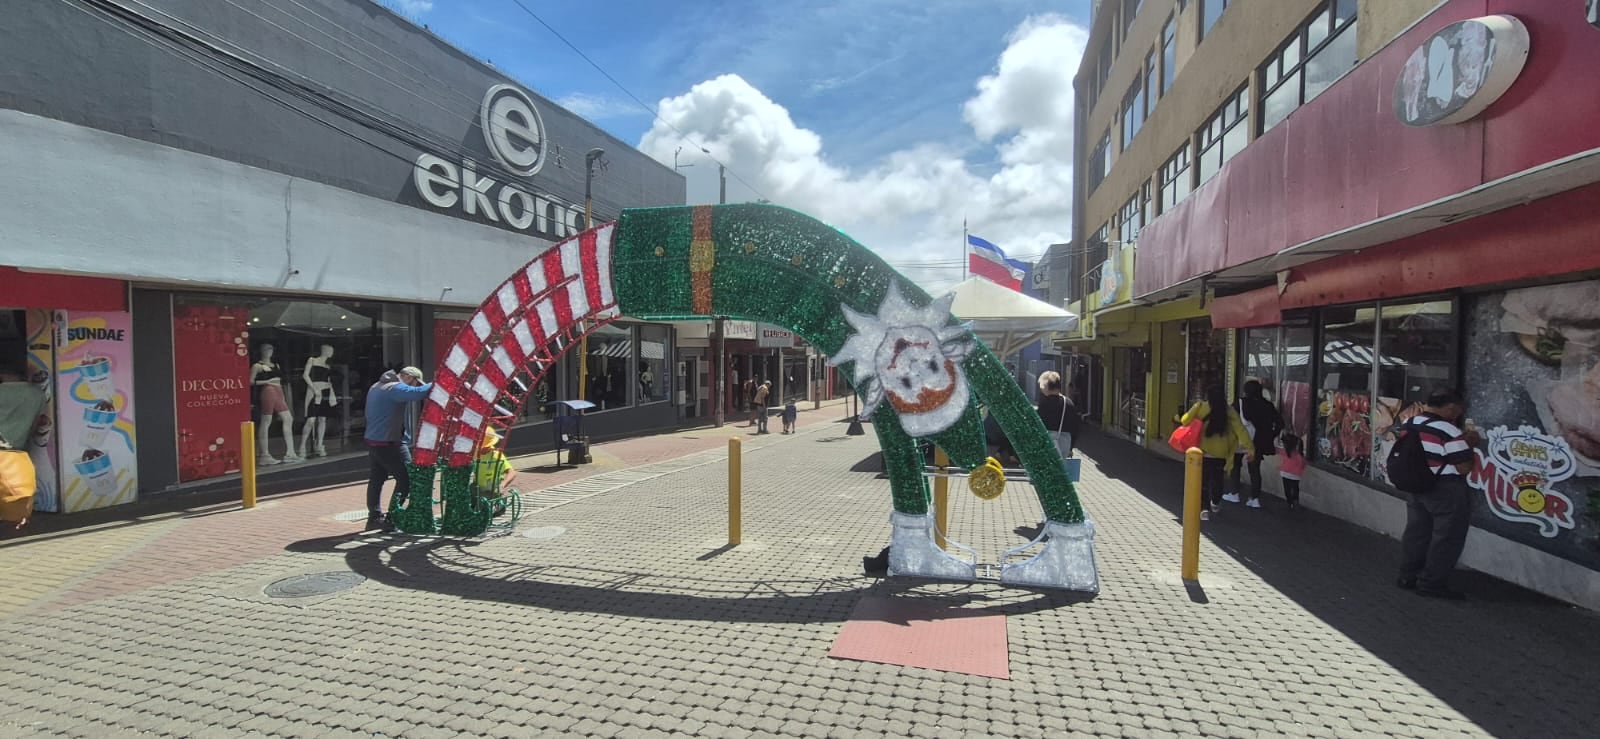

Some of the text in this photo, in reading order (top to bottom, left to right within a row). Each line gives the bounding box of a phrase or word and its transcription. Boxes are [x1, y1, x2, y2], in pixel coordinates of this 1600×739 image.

[489, 96, 541, 167] e
[67, 327, 125, 342] SUNDAE
[186, 398, 241, 408] COLECCIÓN
[199, 393, 230, 401] NUEVA
[1469, 453, 1569, 524] MILOR
